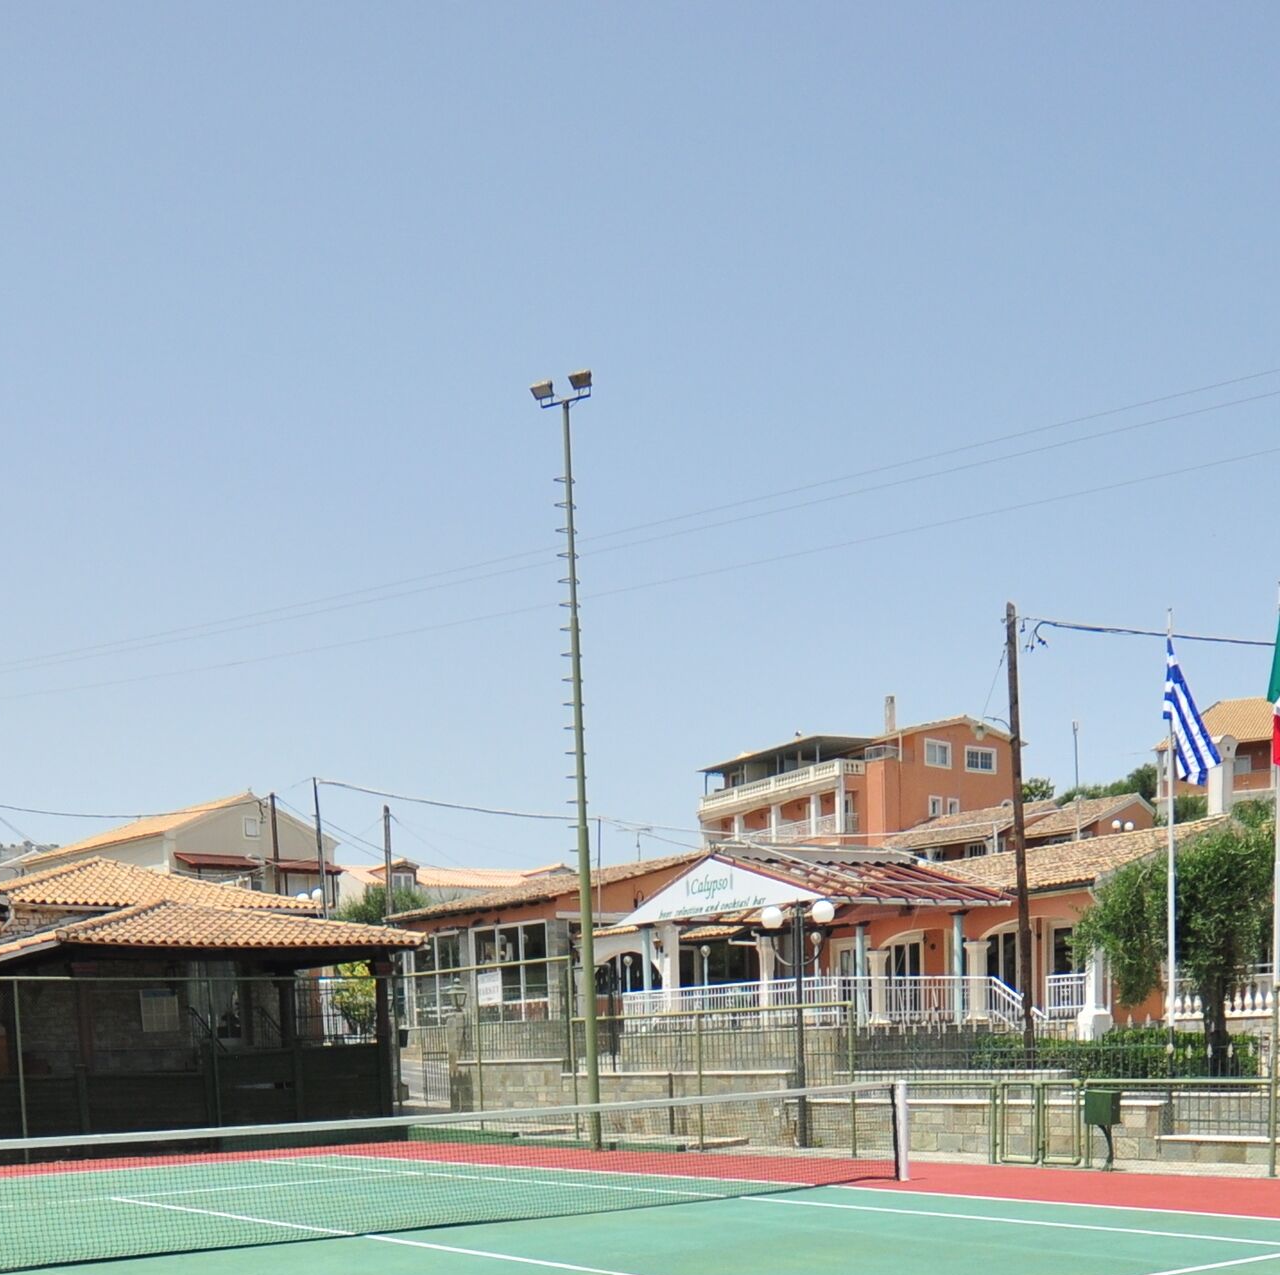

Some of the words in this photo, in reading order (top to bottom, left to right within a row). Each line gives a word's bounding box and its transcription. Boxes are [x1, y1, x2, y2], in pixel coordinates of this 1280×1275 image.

[691, 874, 728, 899] Calypso
[704, 902, 720, 911] and
[752, 895, 766, 905] bar
